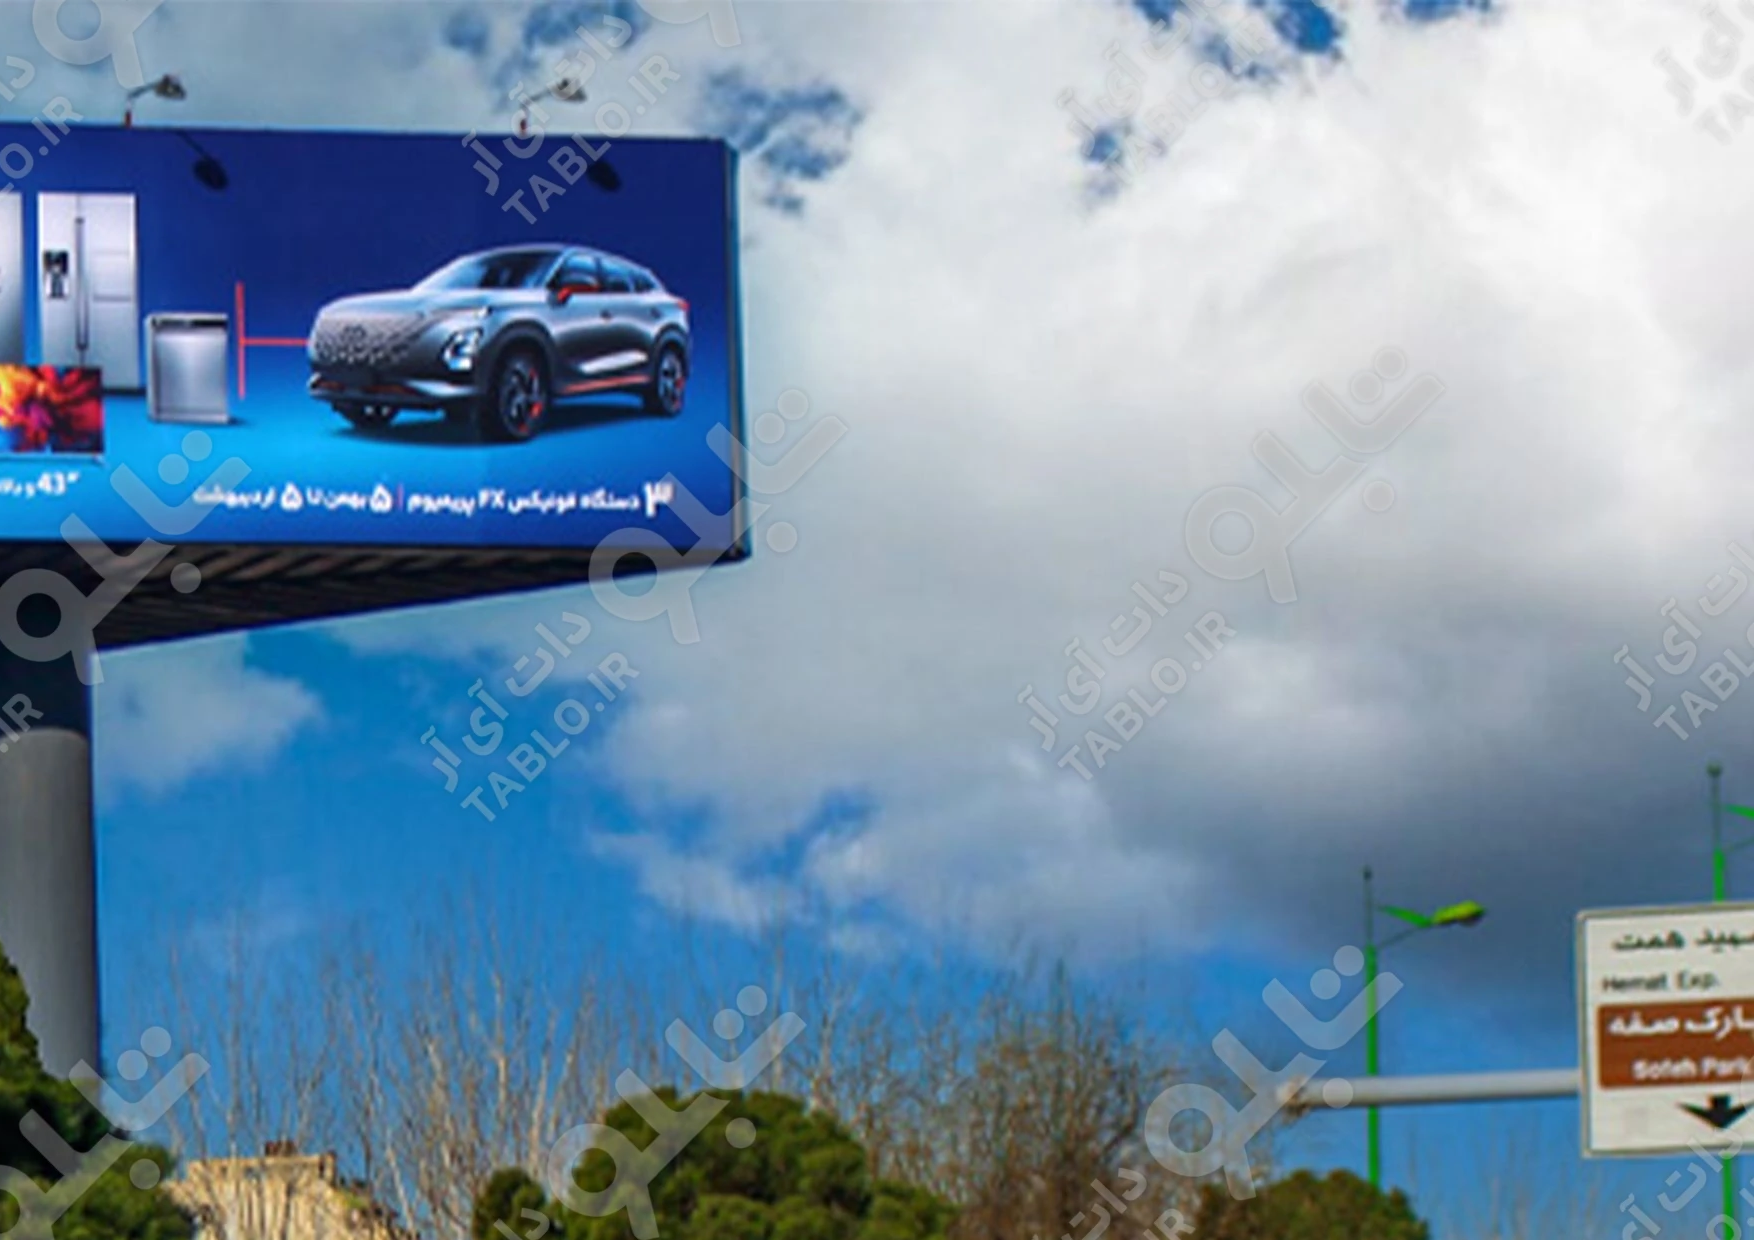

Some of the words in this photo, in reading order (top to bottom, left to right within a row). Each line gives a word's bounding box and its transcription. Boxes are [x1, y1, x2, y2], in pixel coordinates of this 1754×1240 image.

[280, 482, 304, 511] ۵
[369, 482, 393, 513] ۵
[1611, 927, 1686, 951] همت
[1608, 1010, 1680, 1036] صفه
